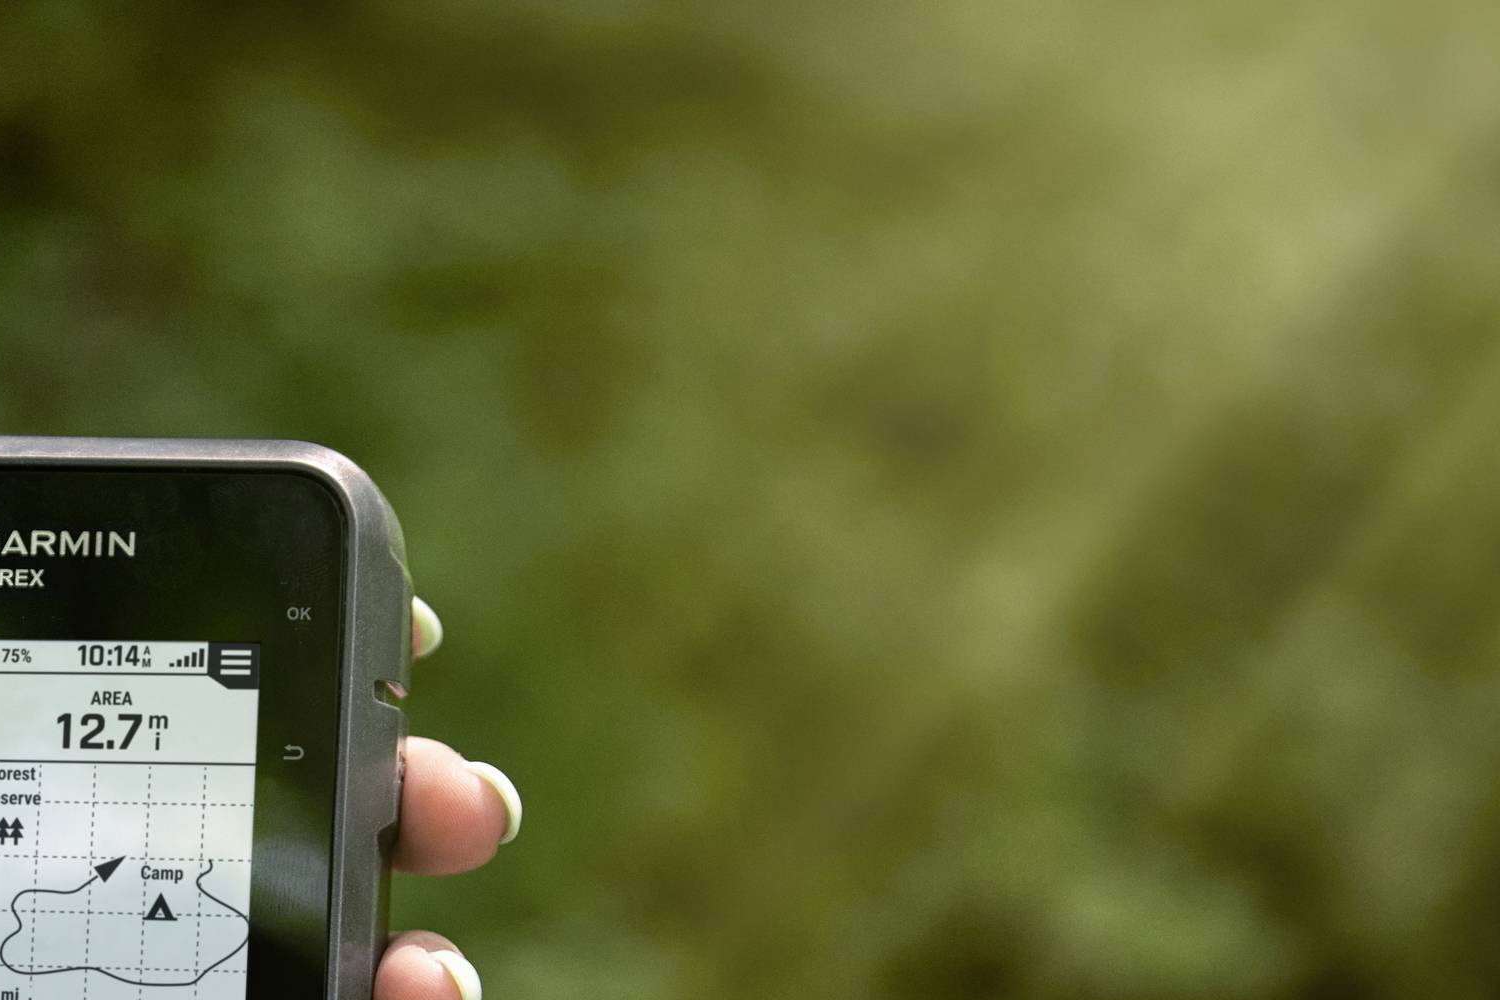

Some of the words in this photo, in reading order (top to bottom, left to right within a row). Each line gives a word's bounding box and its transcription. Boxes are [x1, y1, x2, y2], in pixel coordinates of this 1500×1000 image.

[287, 607, 312, 621] OK
[1, 648, 32, 664] 75%
[77, 644, 140, 668] 10:14
[91, 691, 133, 706] AREA
[56, 713, 143, 750] 12.7
[141, 866, 184, 884] Camp
